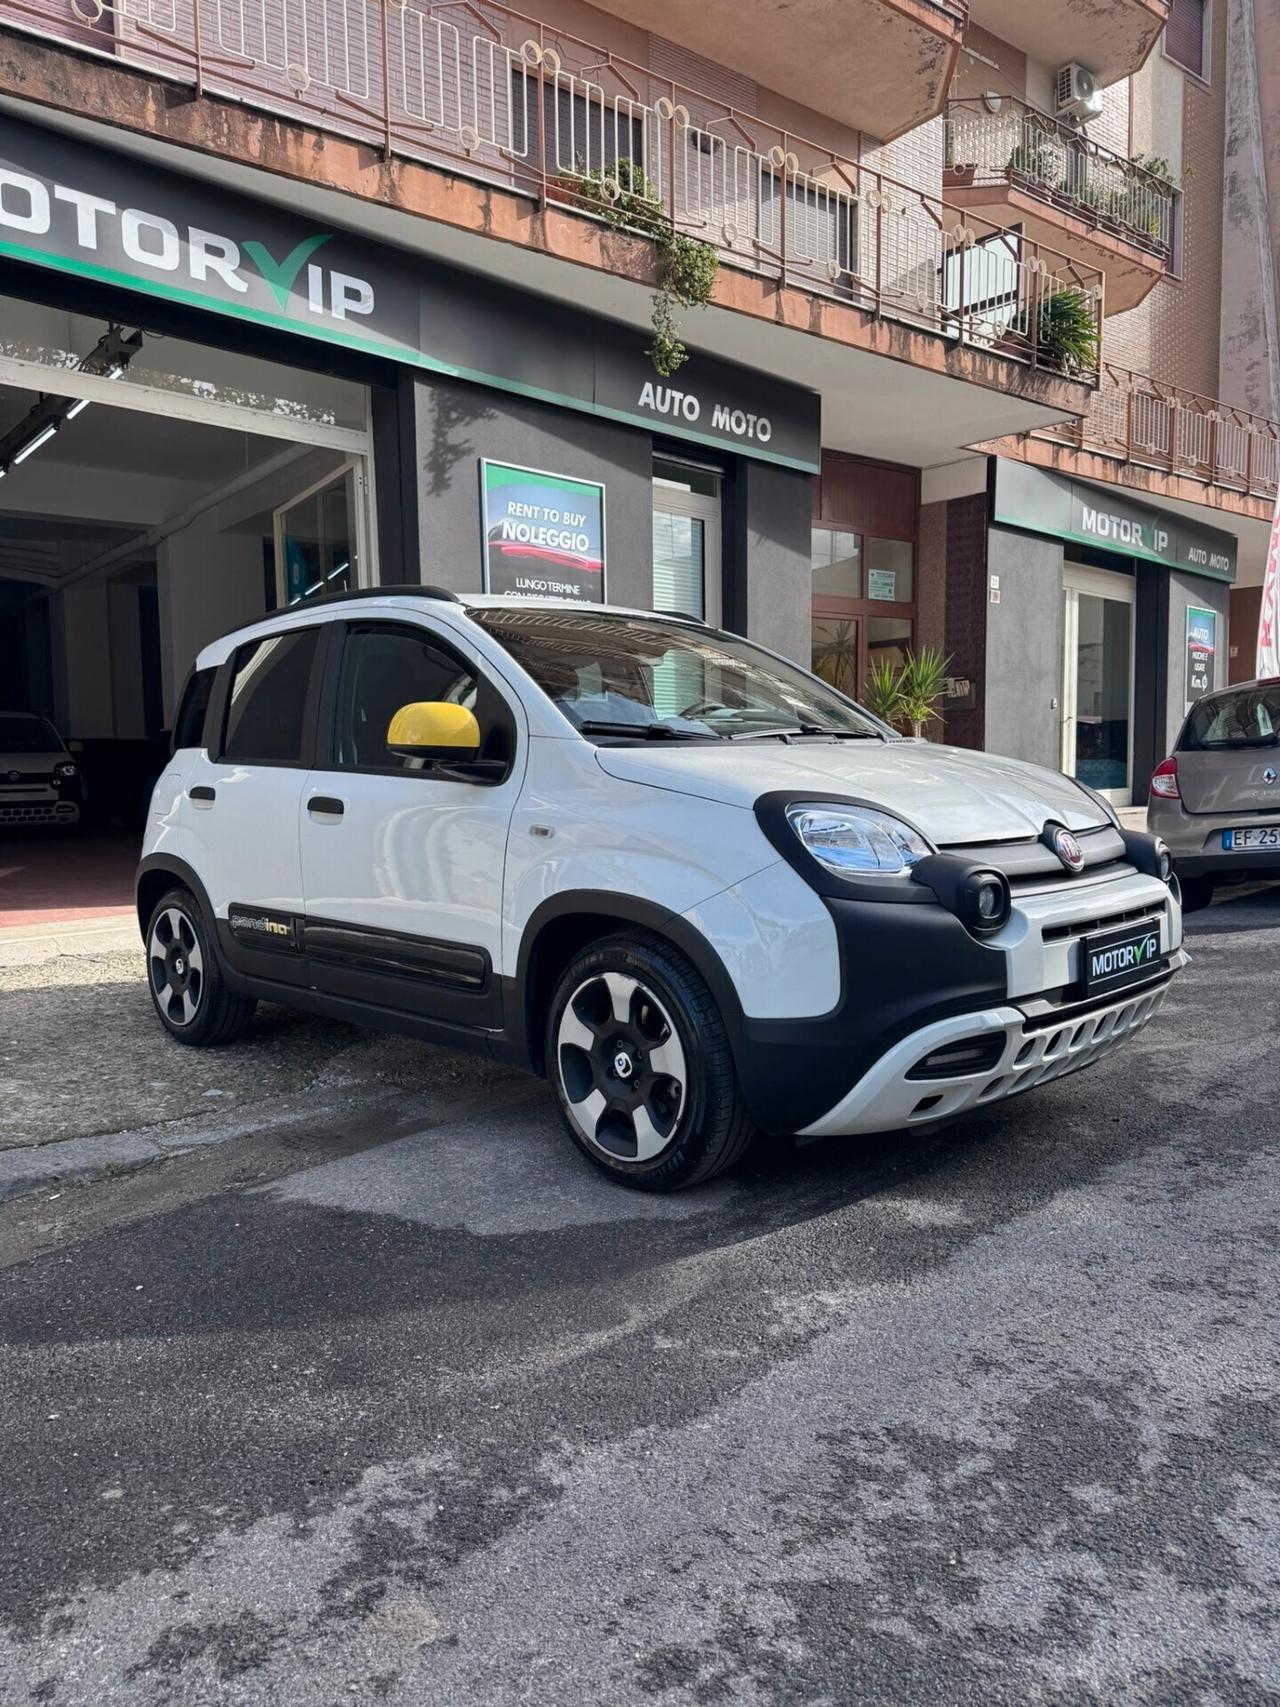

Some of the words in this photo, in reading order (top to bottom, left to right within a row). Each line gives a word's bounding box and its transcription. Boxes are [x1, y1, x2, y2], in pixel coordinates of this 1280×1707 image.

[638, 382, 700, 422] AUTO
[711, 404, 772, 443] MOTO
[507, 501, 540, 519] RENT
[543, 508, 560, 523] TO
[563, 512, 587, 528] BUY
[502, 522, 589, 552] NOLEGGIO
[1188, 546, 1207, 565] AUTO
[1209, 553, 1230, 571] MOTO
[515, 577, 547, 591] LUNGO
[547, 581, 580, 595] TERMINE
[1234, 831, 1252, 846] EF
